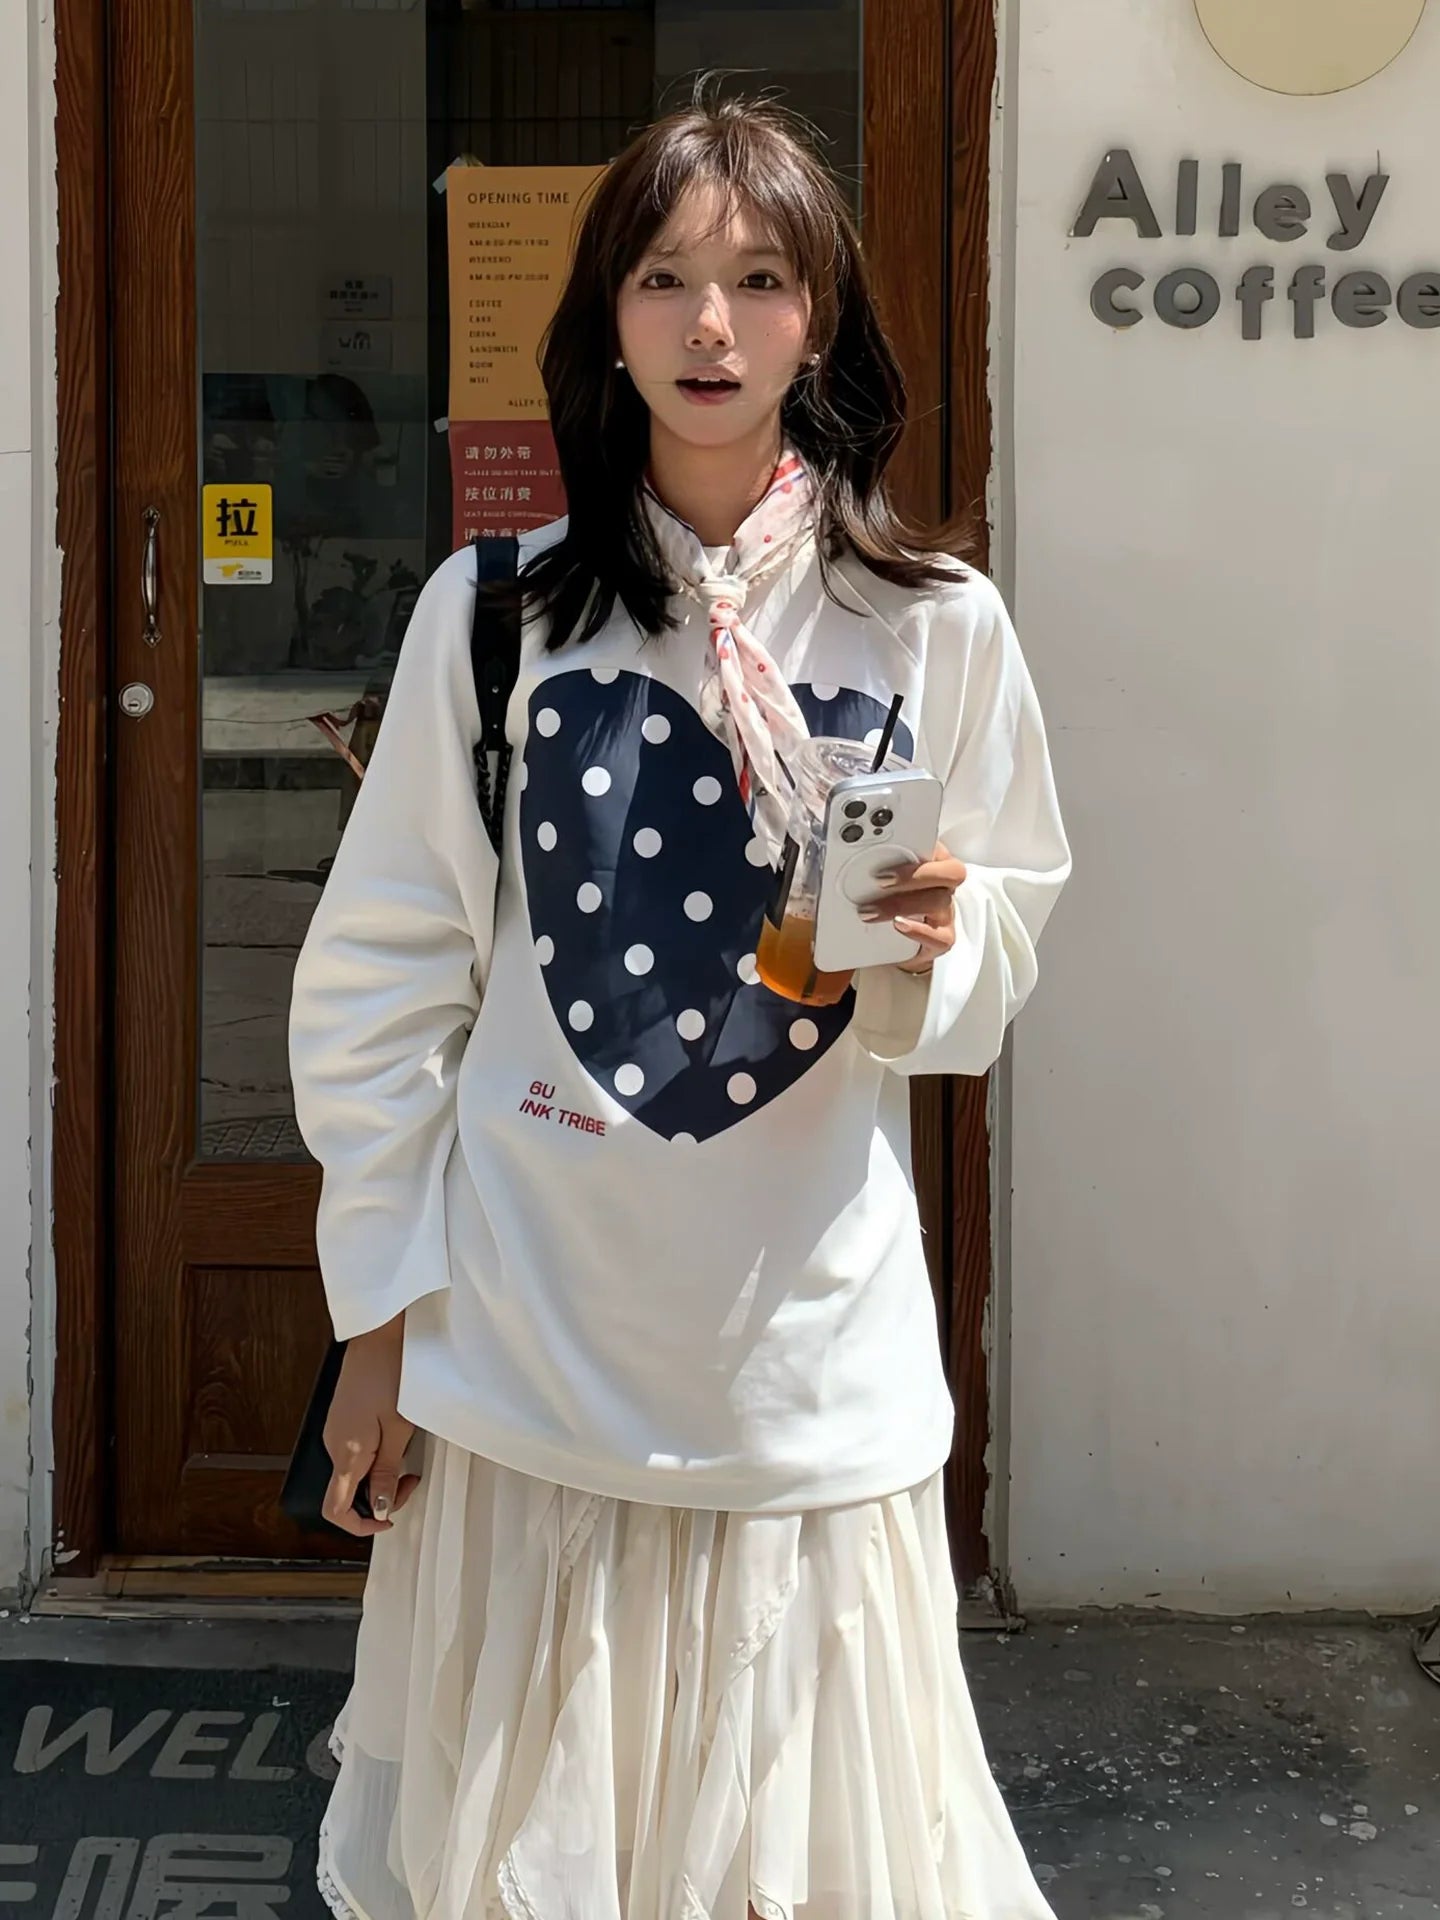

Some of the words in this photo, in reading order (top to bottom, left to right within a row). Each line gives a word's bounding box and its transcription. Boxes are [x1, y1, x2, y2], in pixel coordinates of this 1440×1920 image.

[467, 192, 532, 204] OPENING
[536, 192, 570, 204] TIME
[1067, 149, 1390, 251] Alley
[1090, 265, 1440, 340] coffee
[464, 486, 532, 502] 按位消费
[216, 498, 259, 537] 拉
[529, 1080, 556, 1100] 6U
[519, 1098, 555, 1121] INK
[558, 1109, 607, 1137] TRIBE
